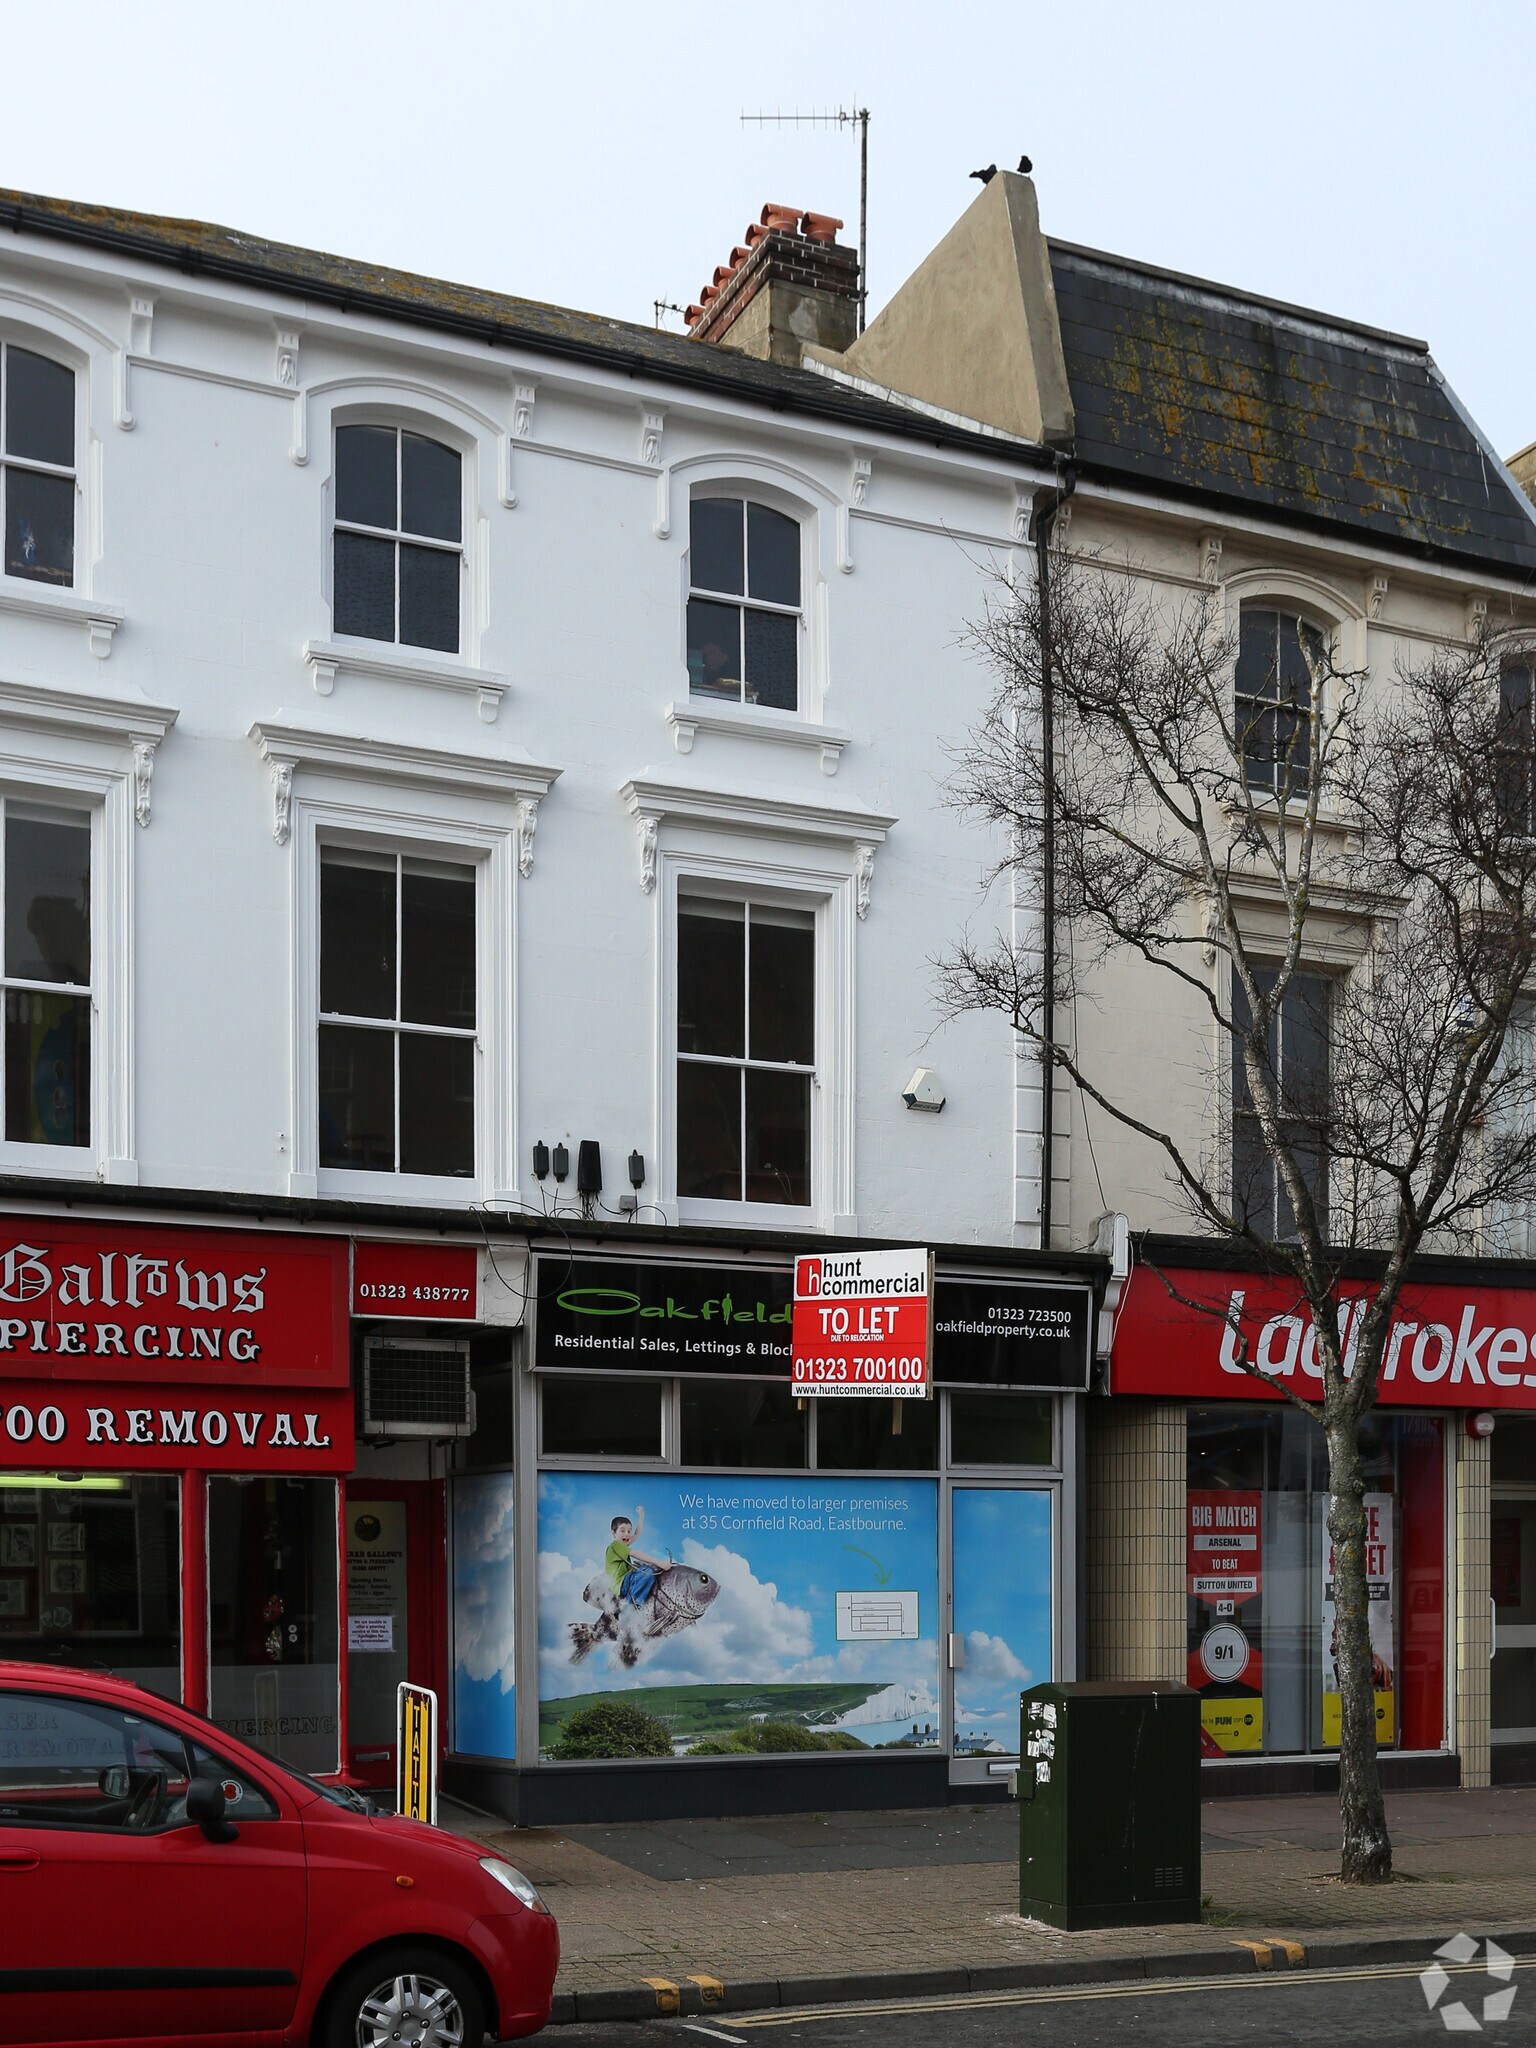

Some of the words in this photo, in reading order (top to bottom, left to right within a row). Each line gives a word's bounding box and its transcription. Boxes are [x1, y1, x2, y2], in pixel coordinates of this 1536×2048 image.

[823, 1257, 861, 1278] hunt
[0, 1243, 267, 1313] Gallows
[822, 1271, 924, 1296] commercial
[360, 1283, 406, 1299] 01323
[412, 1286, 470, 1301] 438777
[818, 1307, 849, 1335] TO
[858, 1306, 900, 1334] LET
[988, 1307, 1025, 1320] 01323
[1028, 1309, 1072, 1323] 723500
[830, 1334, 842, 1342] DUE
[842, 1334, 850, 1342] TO
[850, 1333, 885, 1342] RELOCATION
[935, 1320, 1071, 1339] oakfieldproperty.co.uk
[1218, 1290, 1536, 1387] Ladroke
[0, 1318, 260, 1361] PIERCING
[554, 1334, 635, 1351] Residential
[640, 1338, 680, 1354] Sales,
[685, 1340, 741, 1357] Lettings
[745, 1342, 756, 1355] &
[795, 1357, 847, 1381] 01323
[853, 1357, 923, 1381] 700100
[795, 1384, 921, 1396] www.huntcommercial.co.uk
[0, 1405, 66, 1442] OO
[86, 1407, 330, 1447] REMOVAL
[679, 1494, 704, 1508] We
[707, 1494, 740, 1509] have
[742, 1495, 789, 1510] moved
[791, 1497, 806, 1510] to
[807, 1496, 847, 1513] larger
[850, 1496, 909, 1513] premises
[682, 1516, 696, 1529] at
[699, 1515, 718, 1530] 35
[720, 1515, 785, 1530] Cornfield
[788, 1516, 825, 1531] Road,
[828, 1516, 907, 1531] Eastbourne.
[1192, 1506, 1213, 1527] BIG
[1215, 1506, 1257, 1527] MATCH
[1208, 1537, 1242, 1547] ARSENAL
[1211, 1558, 1221, 1570] TO
[1222, 1558, 1238, 1570] BEAT
[1197, 1580, 1226, 1590] SUTTON
[1227, 1580, 1253, 1589] UNITED
[1217, 1603, 1233, 1613] 4-0
[1214, 1644, 1234, 1660] 9/1
[0, 1712, 58, 1731] SER
[1215, 1716, 1232, 1725] FUN
[2, 1737, 126, 1759] REMOVA
